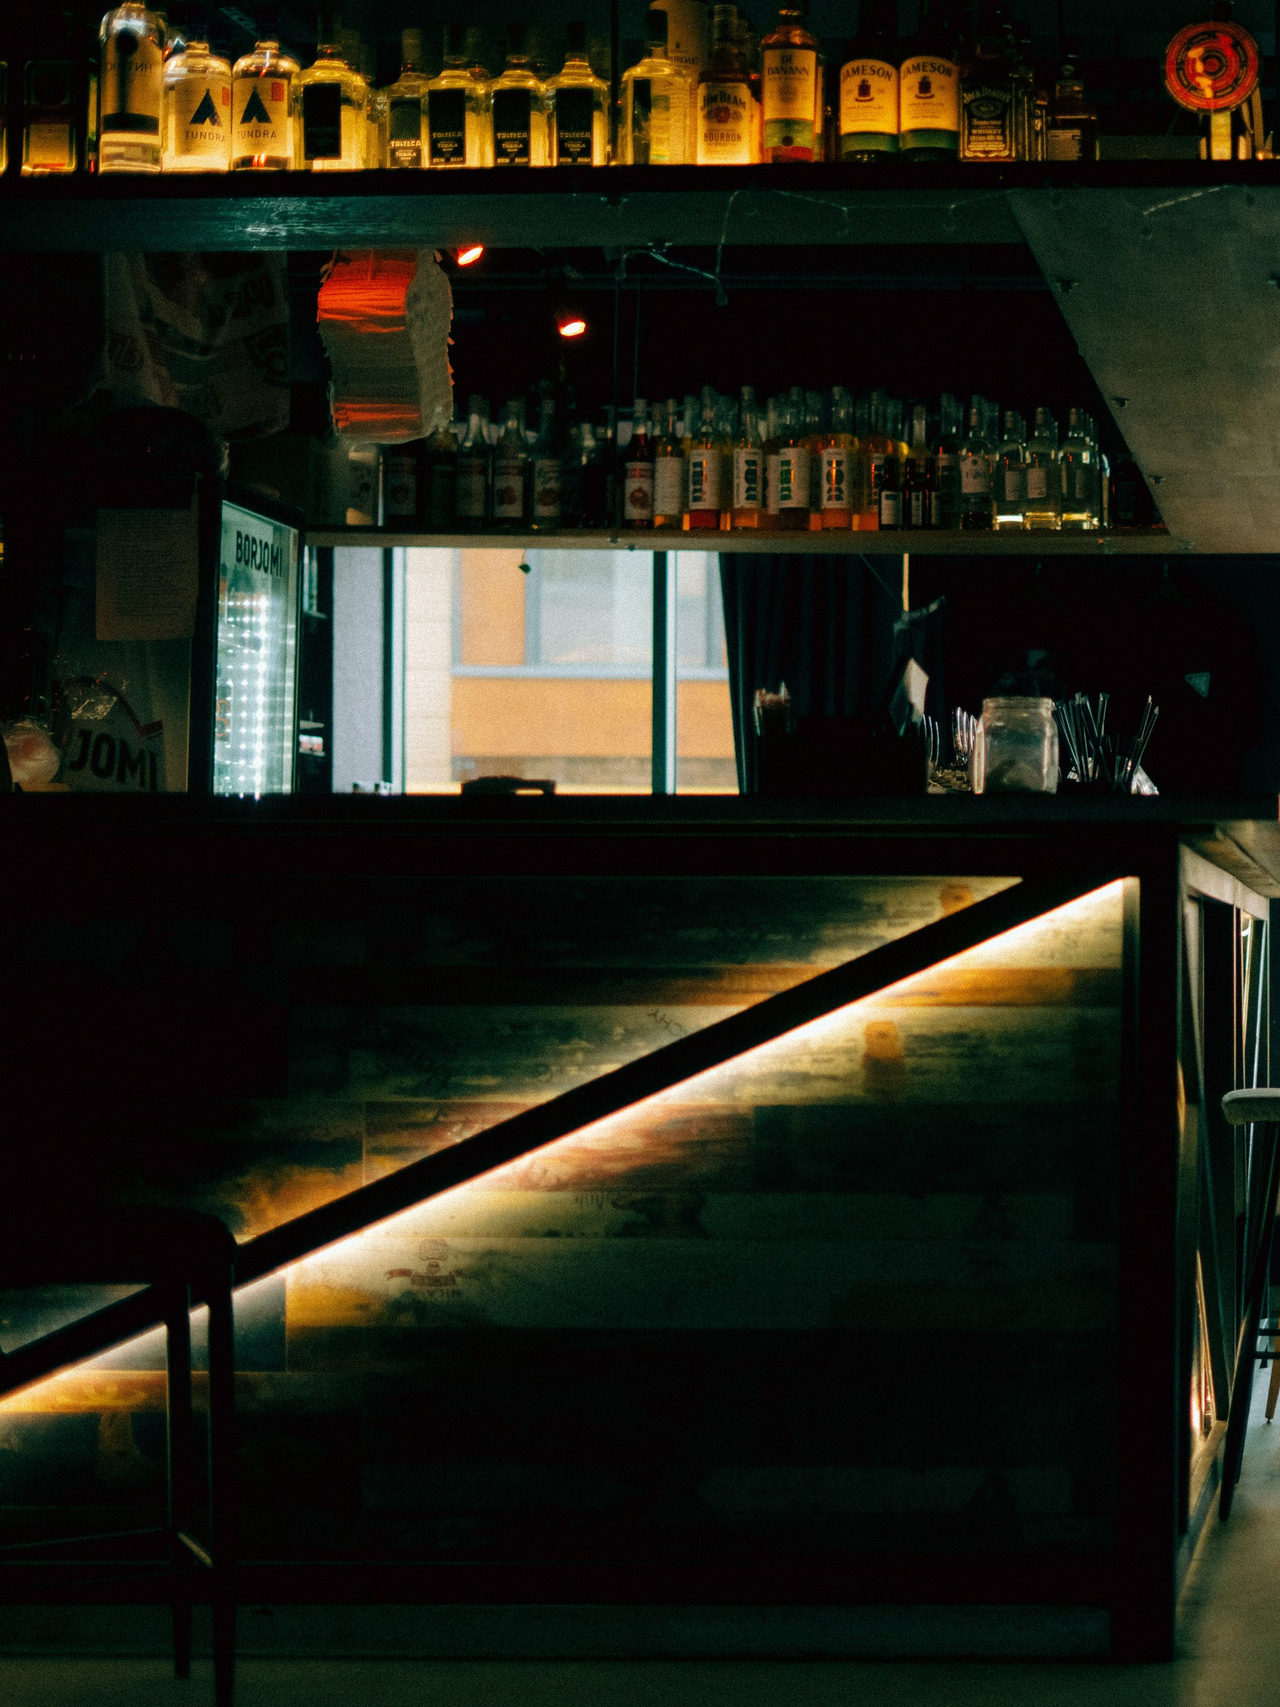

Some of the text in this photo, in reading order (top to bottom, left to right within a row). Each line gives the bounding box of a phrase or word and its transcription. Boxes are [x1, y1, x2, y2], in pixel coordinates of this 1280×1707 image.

[842, 65, 893, 84] JAMESON
[903, 61, 953, 80] JAMESON
[185, 130, 226, 142] TUNDRA
[237, 129, 277, 139] TUNDRA
[236, 530, 283, 577] BORJOMI
